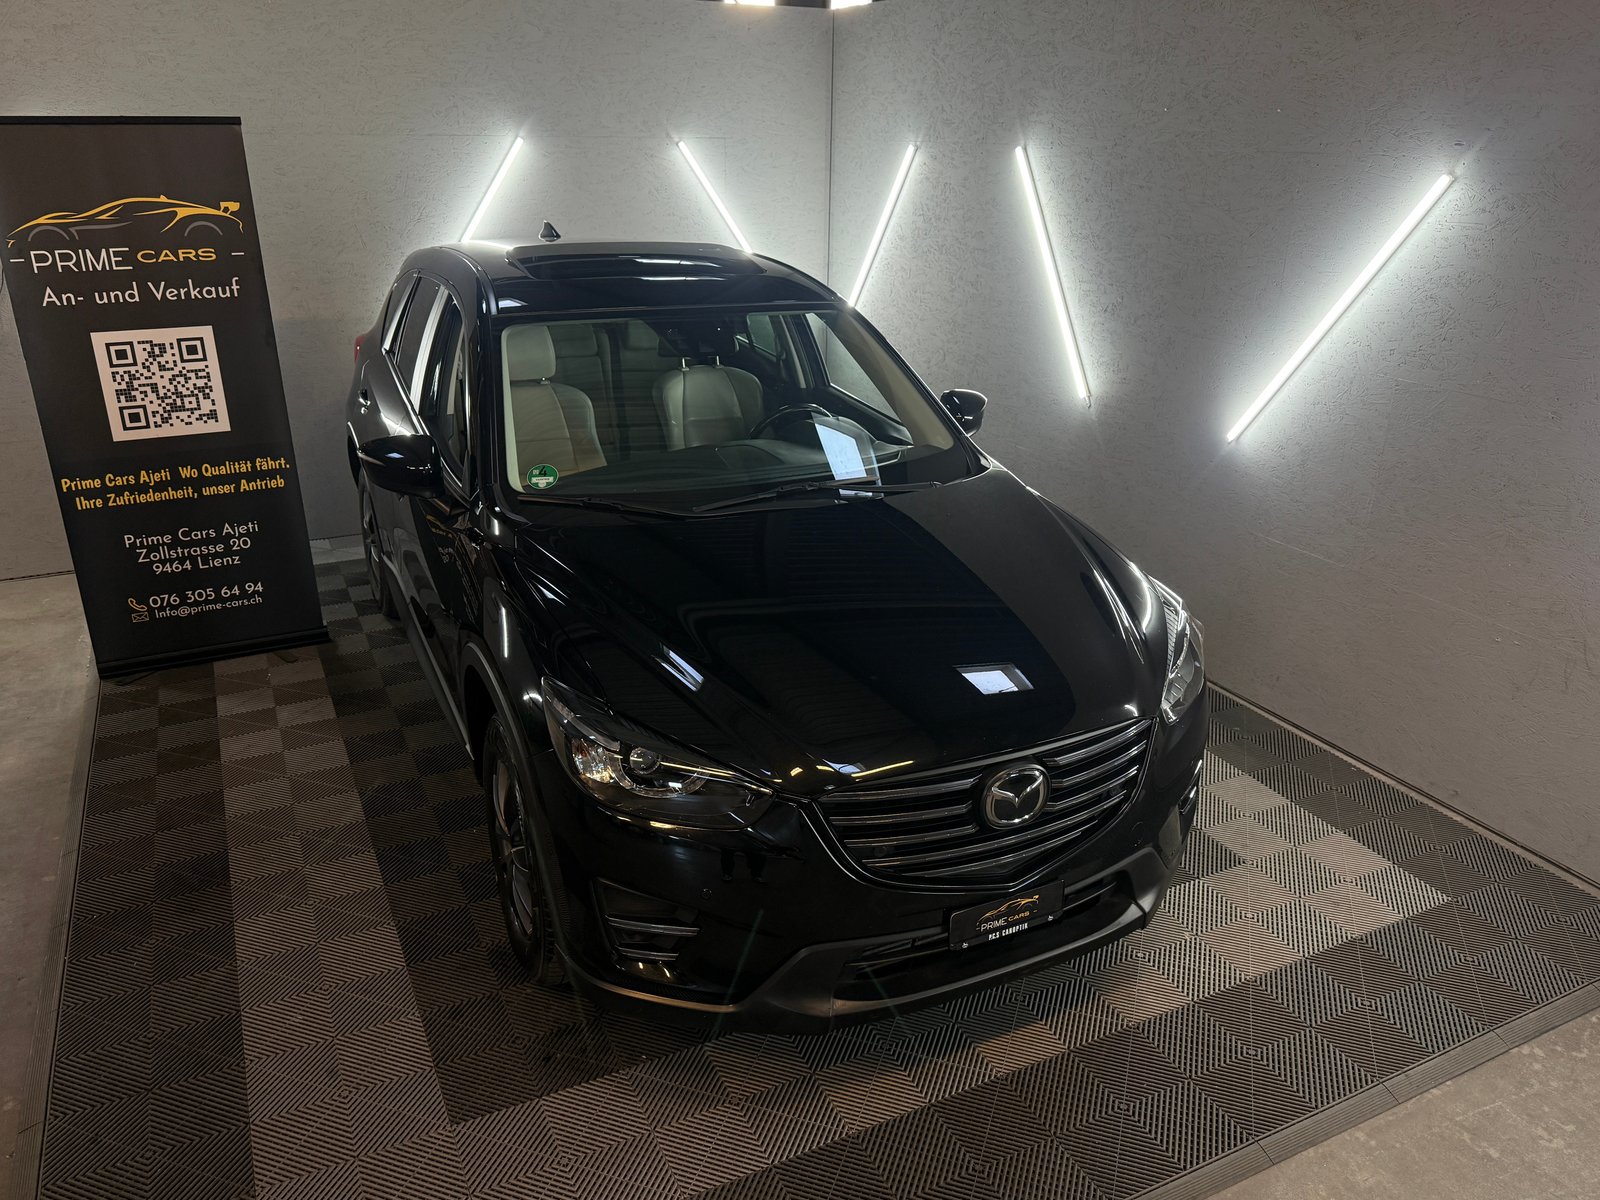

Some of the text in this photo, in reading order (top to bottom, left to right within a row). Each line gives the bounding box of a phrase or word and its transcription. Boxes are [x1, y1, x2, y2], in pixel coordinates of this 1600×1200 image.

[30, 247, 217, 274] PRIME CARS
[42, 276, 240, 307] An- und Verkauf
[60, 456, 290, 493] Prime Cars Ajeti Wo Qualität fährt.
[75, 475, 285, 511] Ihre Zufriedenheit, unser Antrieb
[124, 520, 260, 549] Prime Cars Ajeti
[136, 537, 251, 563] Zollstrasse 20
[152, 555, 241, 575] 9464 Lienz
[149, 581, 264, 609] 076 305 64 94
[154, 594, 263, 619] Info@prime-cars.ch
[981, 911, 1030, 932] PRIME CARS
